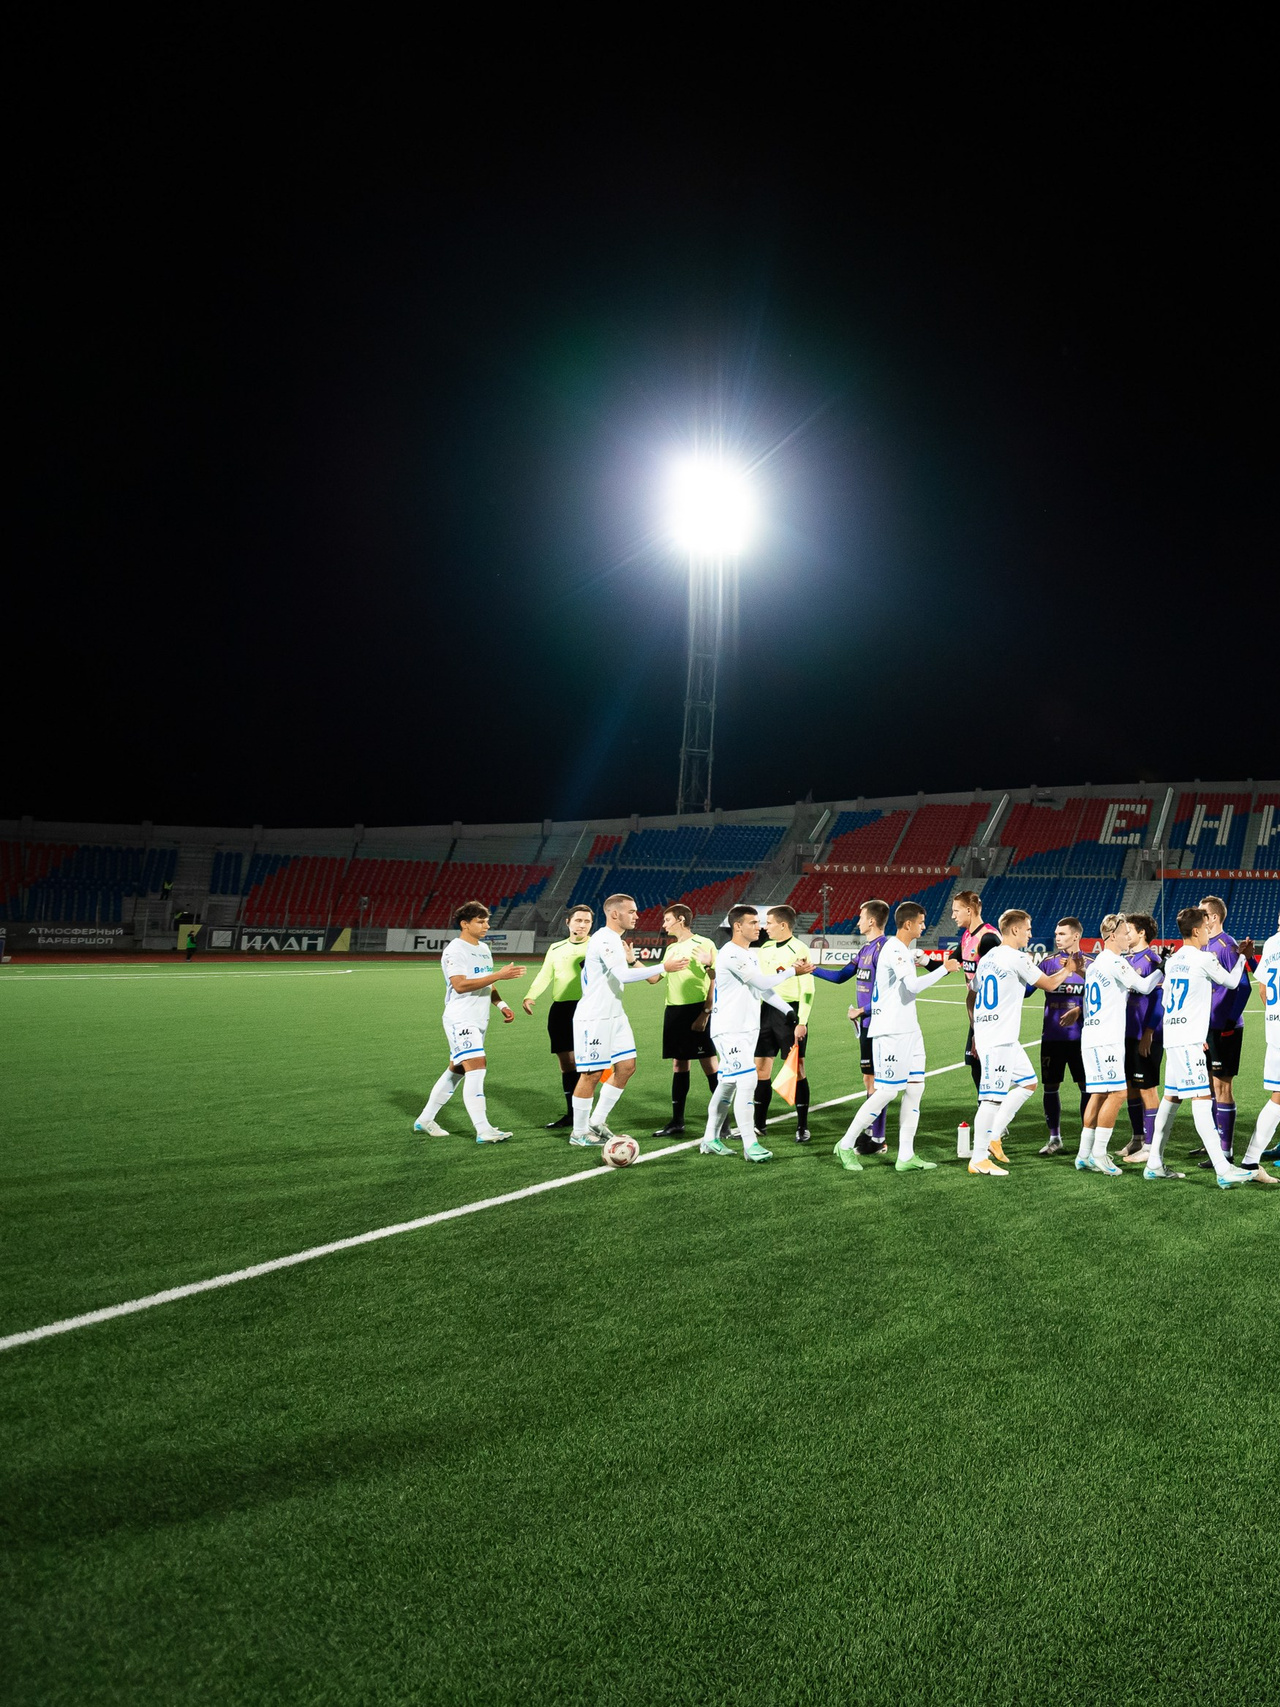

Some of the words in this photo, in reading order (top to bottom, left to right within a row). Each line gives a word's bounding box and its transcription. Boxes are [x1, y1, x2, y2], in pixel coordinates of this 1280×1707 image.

[28, 927, 124, 936] АТМОСФЕРНЫЙ
[37, 936, 114, 945] БАРБЕРШОП
[240, 935, 324, 951] ИЛАН
